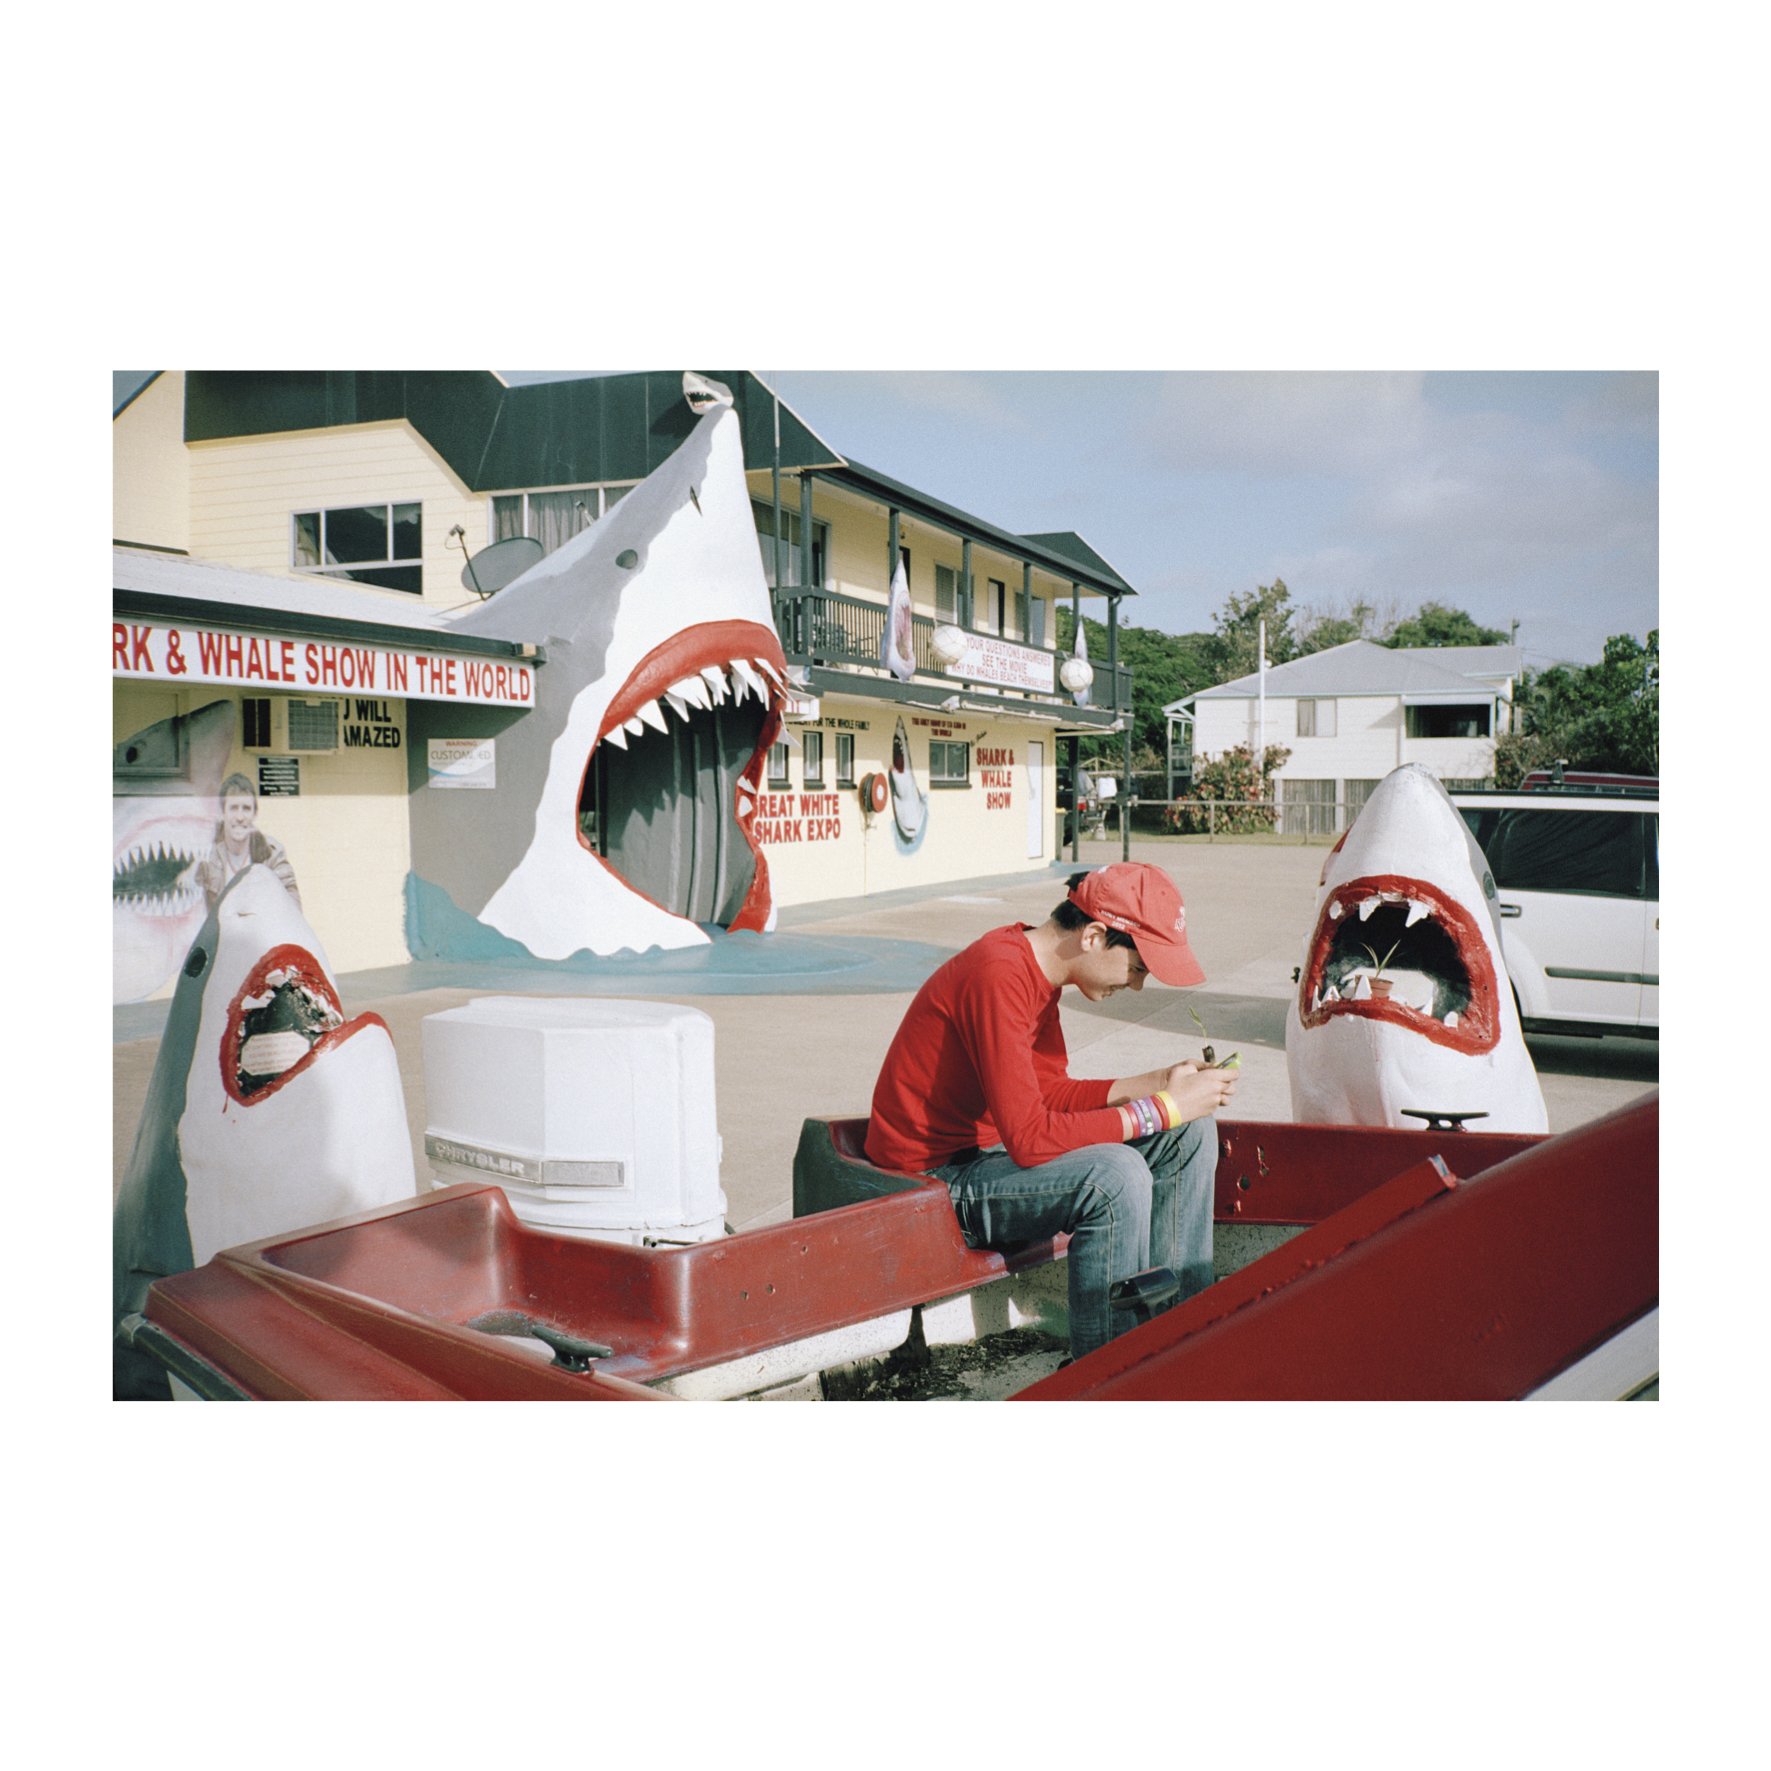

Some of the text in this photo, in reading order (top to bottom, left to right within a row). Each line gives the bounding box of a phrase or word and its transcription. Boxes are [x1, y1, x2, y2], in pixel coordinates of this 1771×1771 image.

[966, 636, 985, 651] YOUR
[986, 639, 1020, 660] QUESTIONS
[166, 629, 187, 675] &
[197, 631, 296, 682] WHALE
[305, 643, 376, 689] SHOW
[386, 653, 408, 692] IN
[415, 656, 457, 695] THE
[463, 661, 530, 701] WORLD
[982, 653, 1027, 676] SEE THE MOVIE
[356, 699, 392, 723] WILL
[825, 717, 836, 728] THE
[976, 748, 1015, 766] SHARK &
[981, 770, 1012, 788] WHALE
[799, 793, 840, 817] WHITE
[986, 791, 1012, 810] SHOW
[754, 817, 841, 844] SHARK EXPO
[435, 1142, 525, 1177] CHRYSLER
